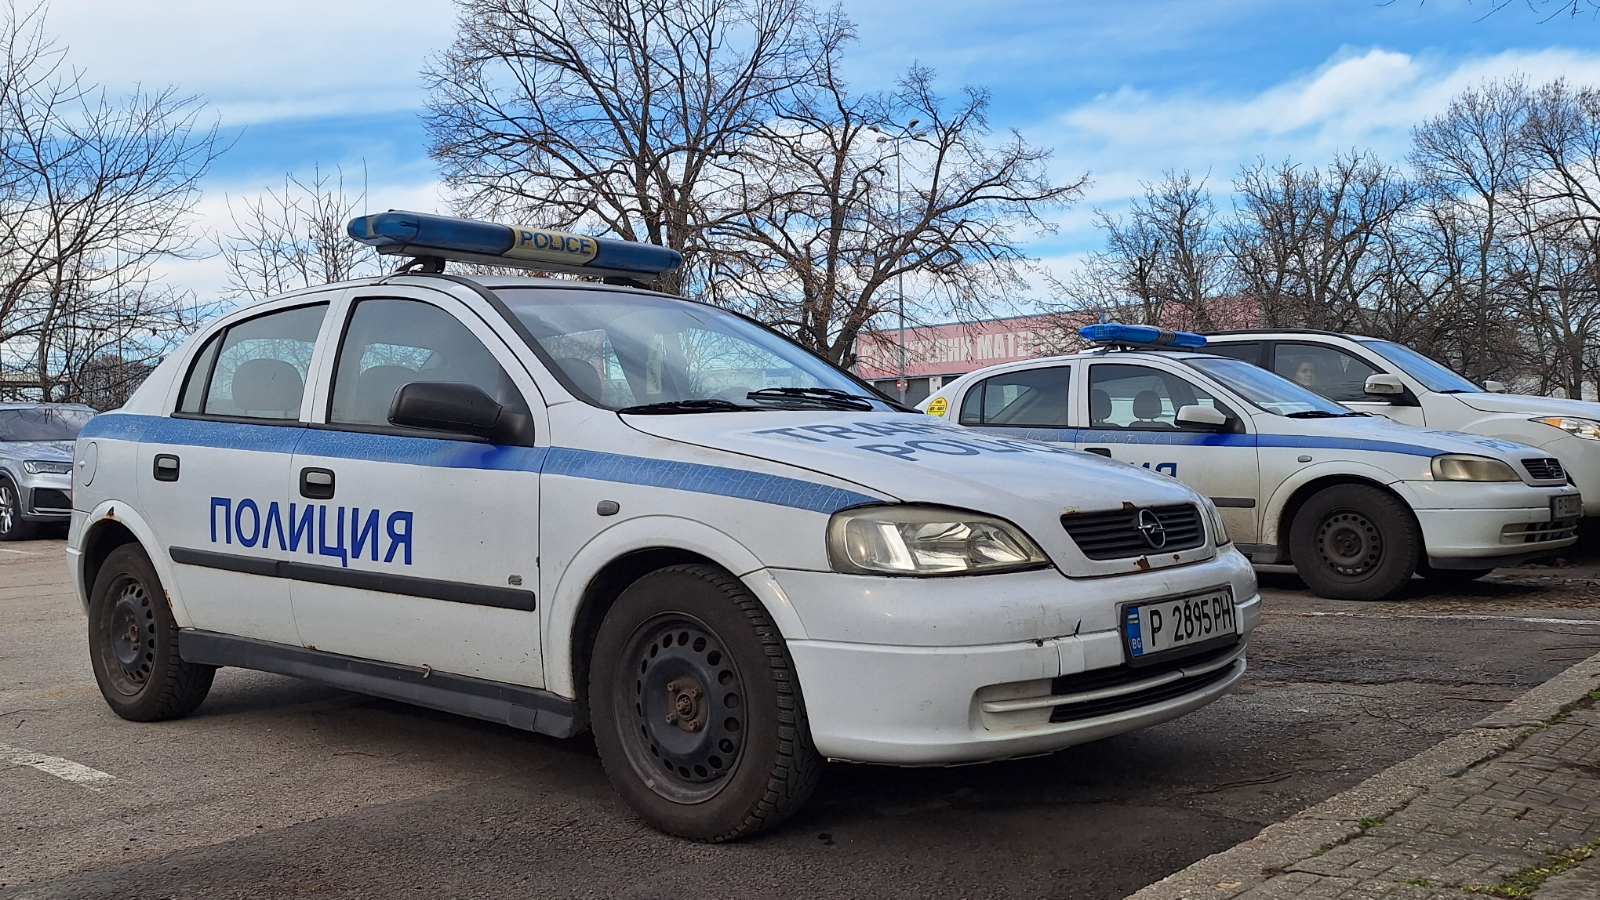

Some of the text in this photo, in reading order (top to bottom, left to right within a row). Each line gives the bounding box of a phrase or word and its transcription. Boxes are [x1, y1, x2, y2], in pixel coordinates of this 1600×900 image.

[520, 231, 593, 256] POLICE
[210, 497, 413, 567] ПОЛИЦИЯ
[1131, 637, 1142, 650] BG
